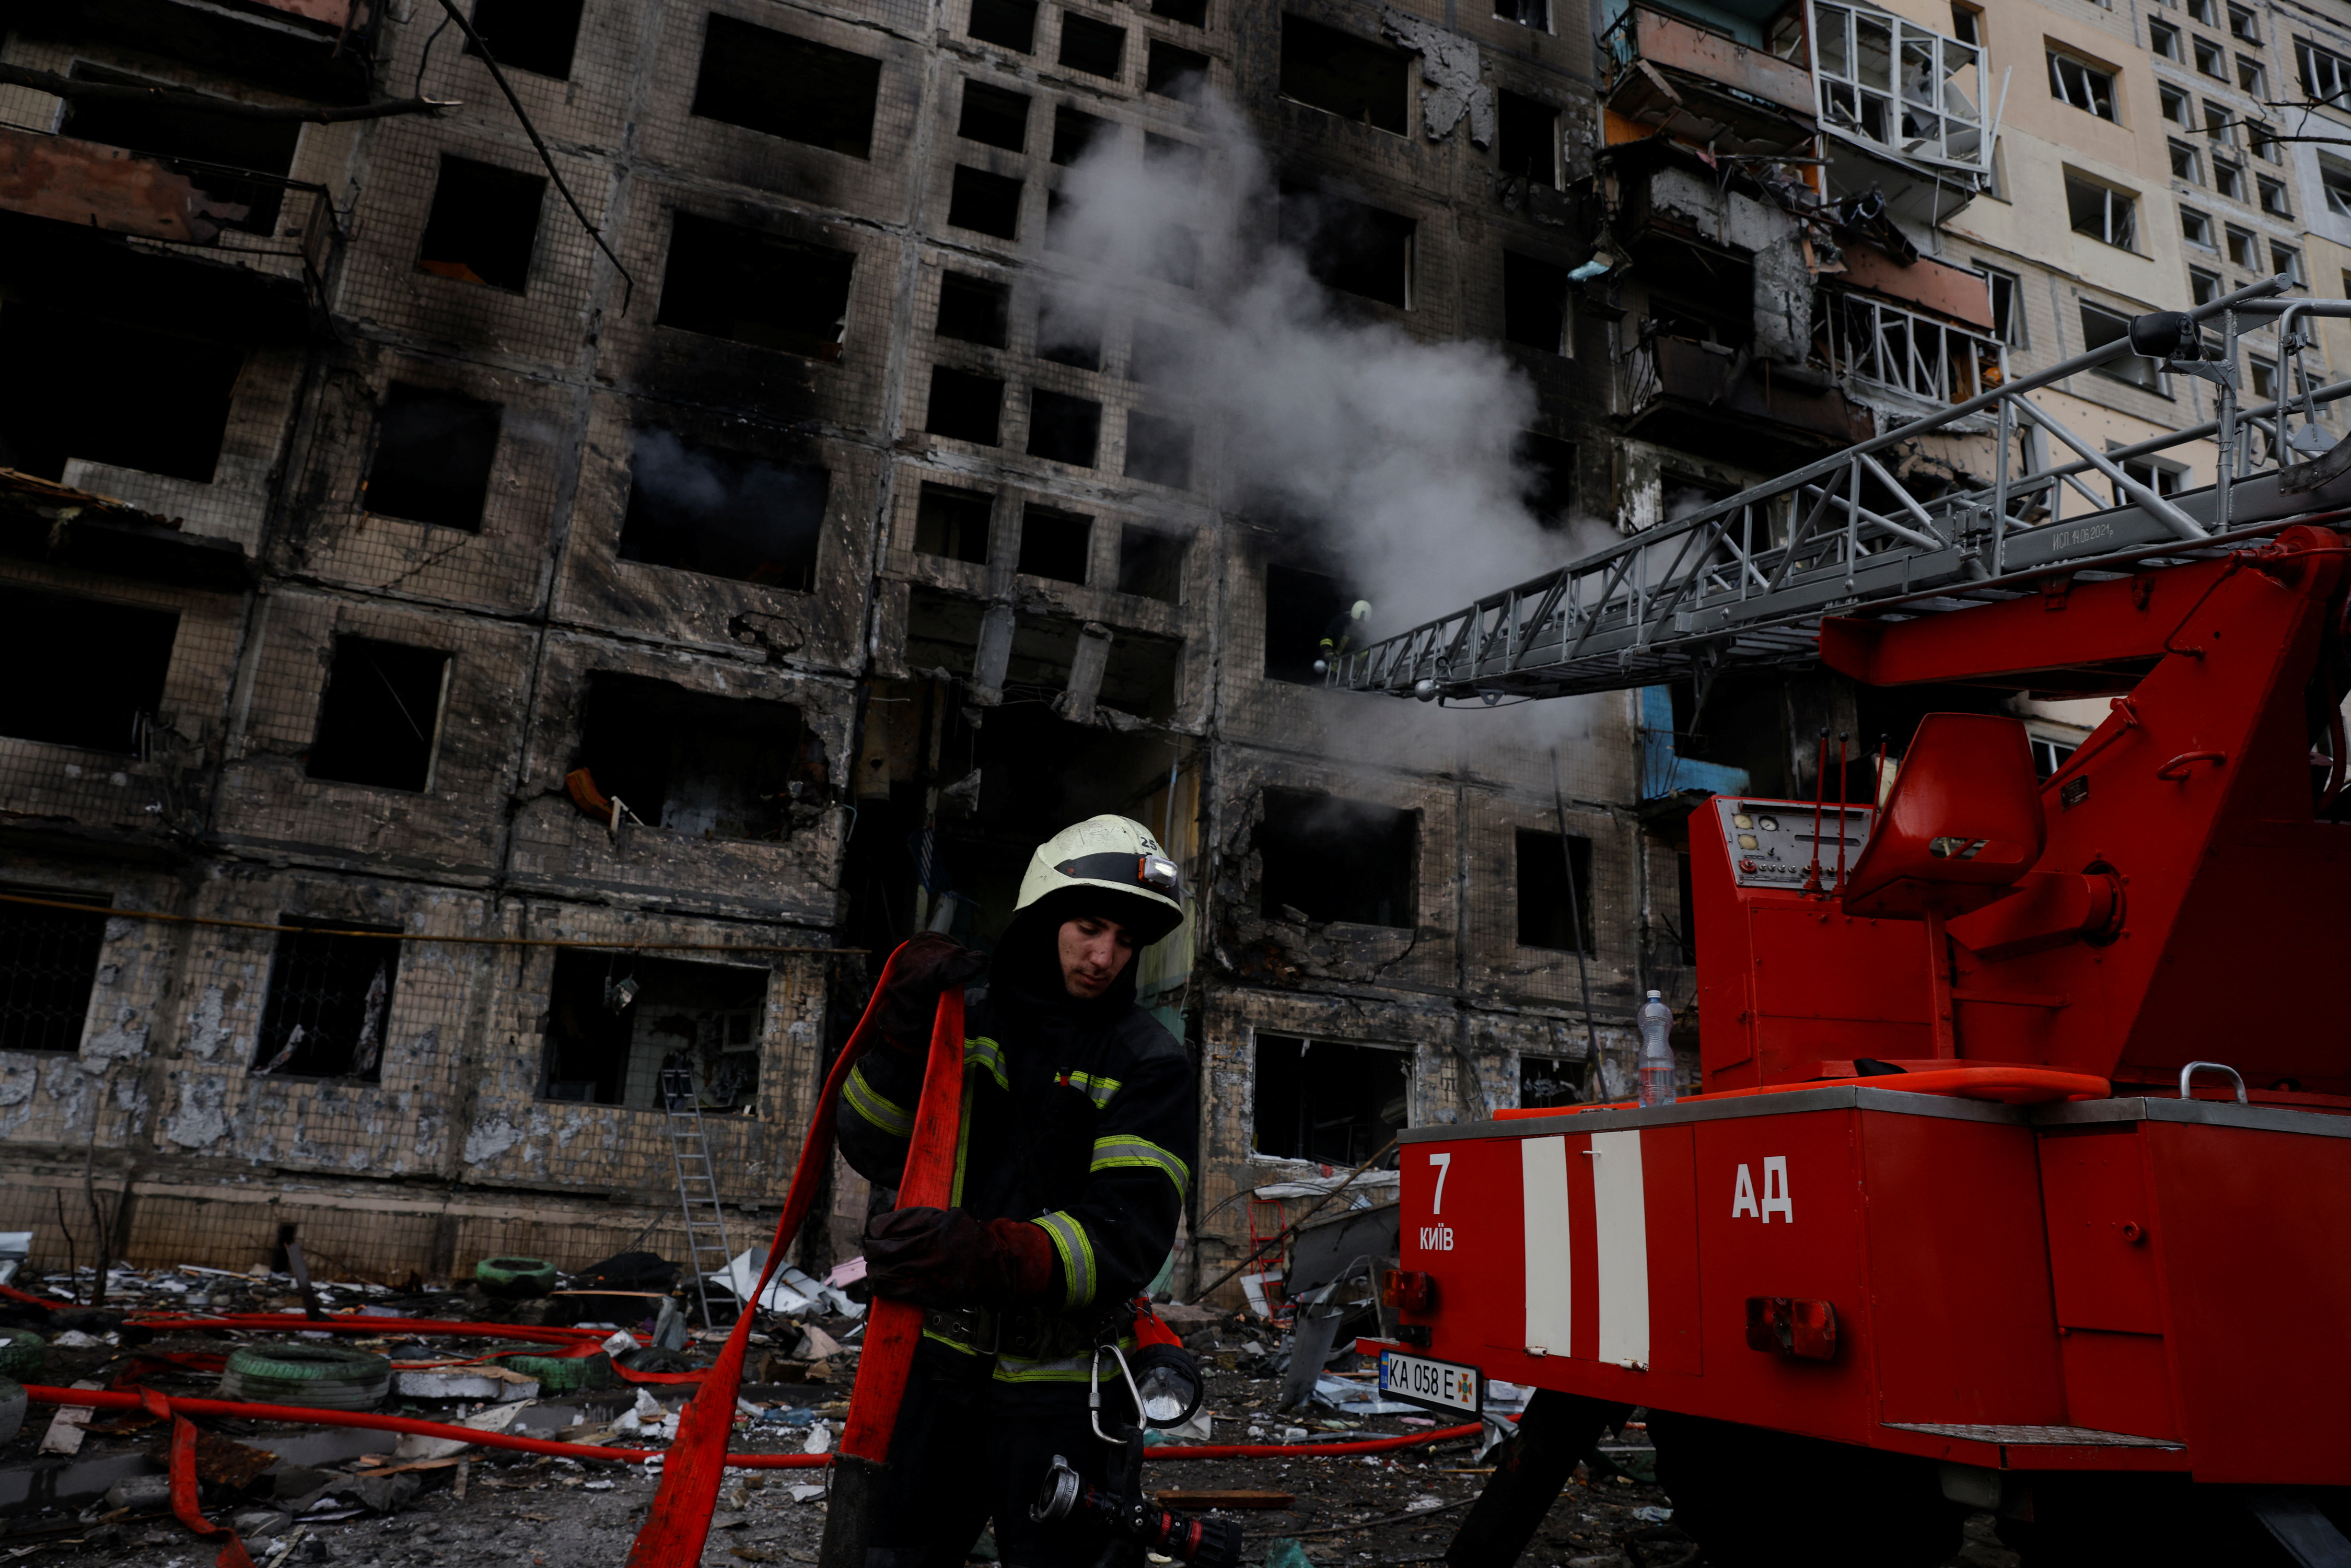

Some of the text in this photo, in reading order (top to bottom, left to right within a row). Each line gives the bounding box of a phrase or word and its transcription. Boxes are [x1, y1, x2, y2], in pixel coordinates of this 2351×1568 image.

[1140, 837, 1157, 851] 25
[1429, 1153, 1450, 1215] 7
[1732, 1155, 1794, 1224] АД
[1420, 1223, 1454, 1251] КИЇВ
[1390, 1358, 1454, 1400] KA 058 E
